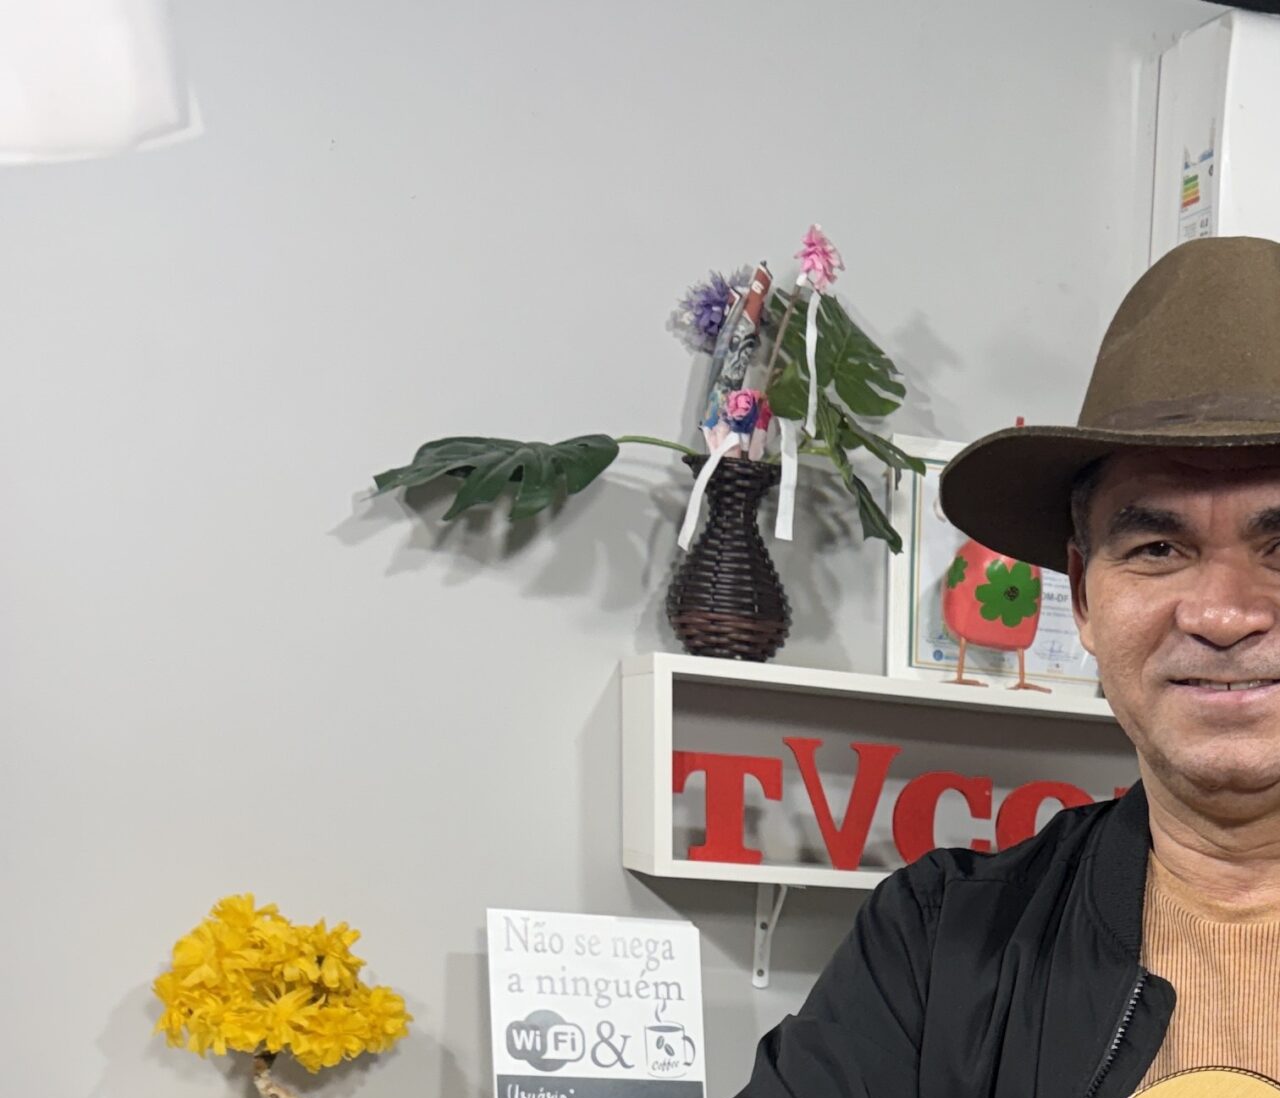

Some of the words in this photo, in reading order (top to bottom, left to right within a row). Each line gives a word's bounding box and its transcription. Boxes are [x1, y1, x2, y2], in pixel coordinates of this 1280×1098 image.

[672, 737, 1136, 868] TVCO
[503, 916, 564, 954] Não
[574, 934, 602, 956] se
[611, 936, 675, 972] nega
[507, 972, 525, 993] a
[536, 965, 685, 1009] ninguém
